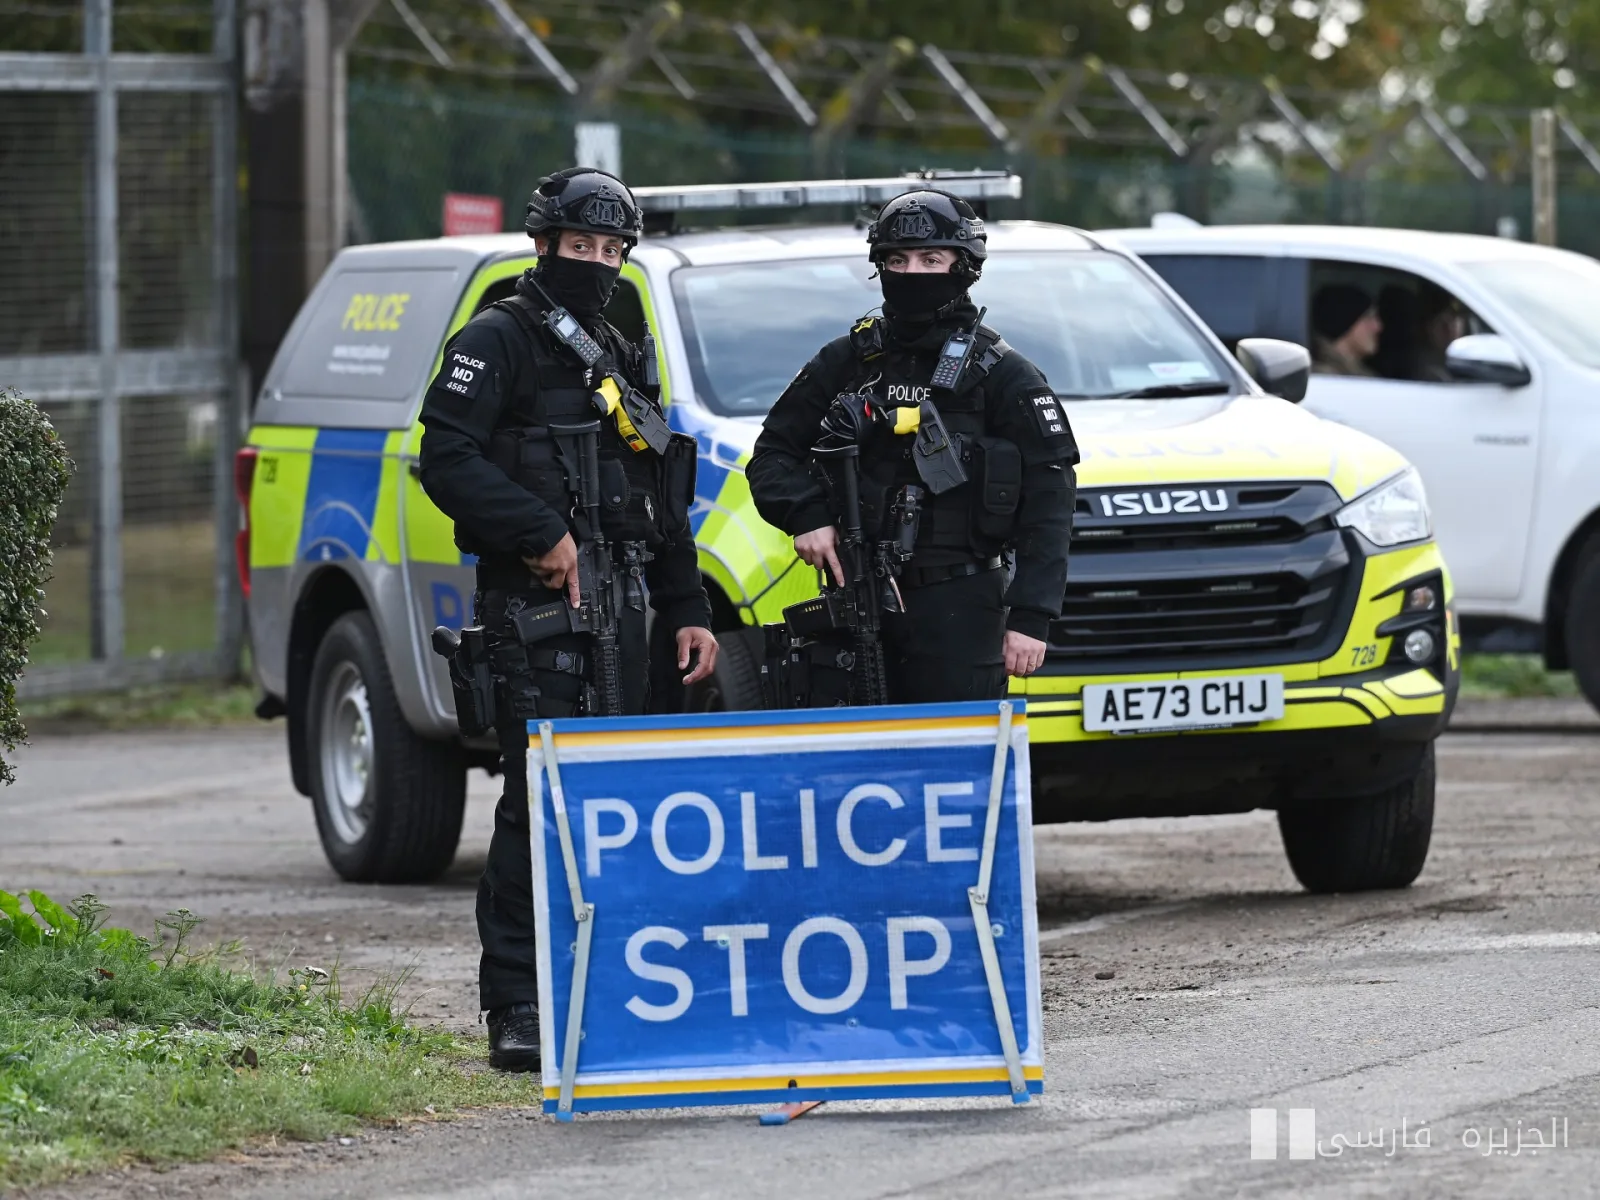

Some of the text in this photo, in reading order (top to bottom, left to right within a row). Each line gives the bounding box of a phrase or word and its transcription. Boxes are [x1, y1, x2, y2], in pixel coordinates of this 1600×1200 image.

[342, 293, 411, 331] POLICE
[453, 353, 486, 370] POLICE
[451, 366, 474, 382] MD
[446, 381, 468, 394] 4582
[887, 385, 932, 402] POLICE
[1042, 408, 1058, 421] MD
[1100, 489, 1229, 516] ISUZU
[1351, 644, 1377, 667] 728
[1101, 680, 1267, 722] AE73 CHJ
[582, 781, 979, 878] POLICE
[624, 916, 952, 1022] STOP
